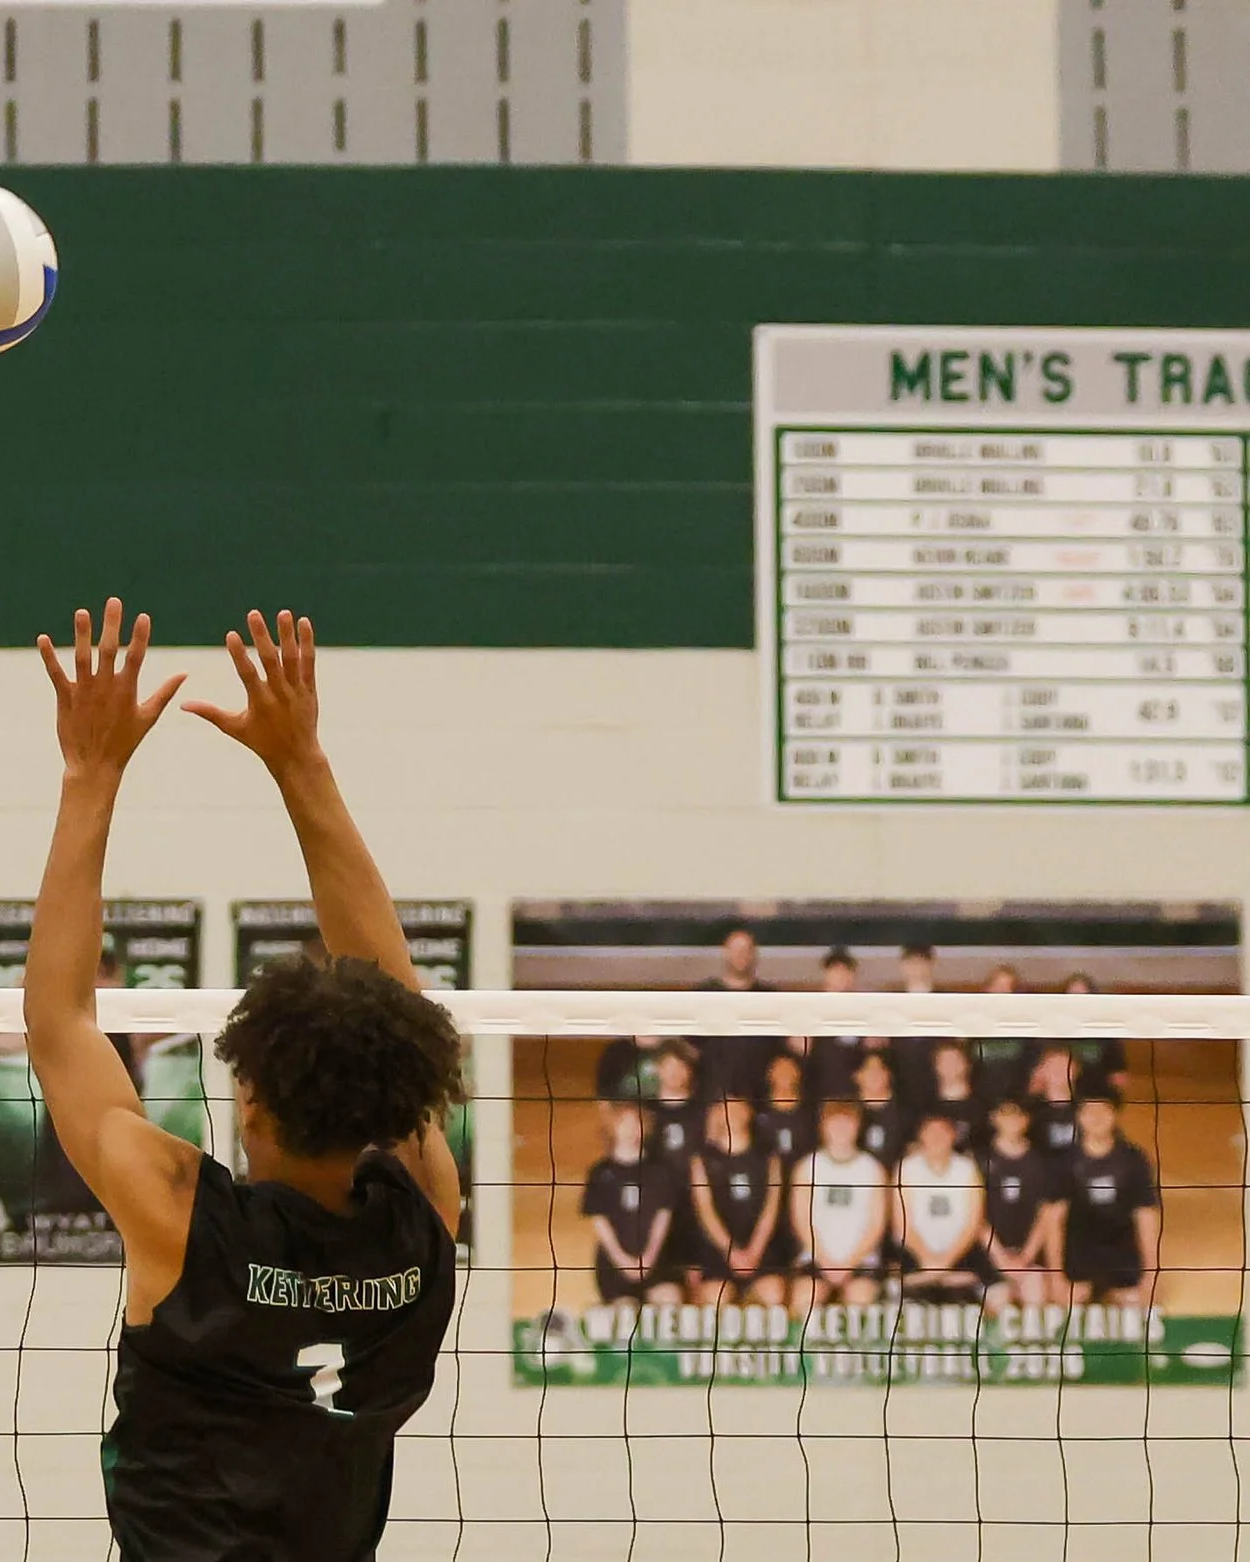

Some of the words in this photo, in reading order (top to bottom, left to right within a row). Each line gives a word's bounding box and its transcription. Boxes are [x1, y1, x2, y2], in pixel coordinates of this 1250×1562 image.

[889, 349, 1073, 402] MEN'S
[1114, 352, 1250, 404] TRA
[247, 1263, 421, 1313] KETTERING
